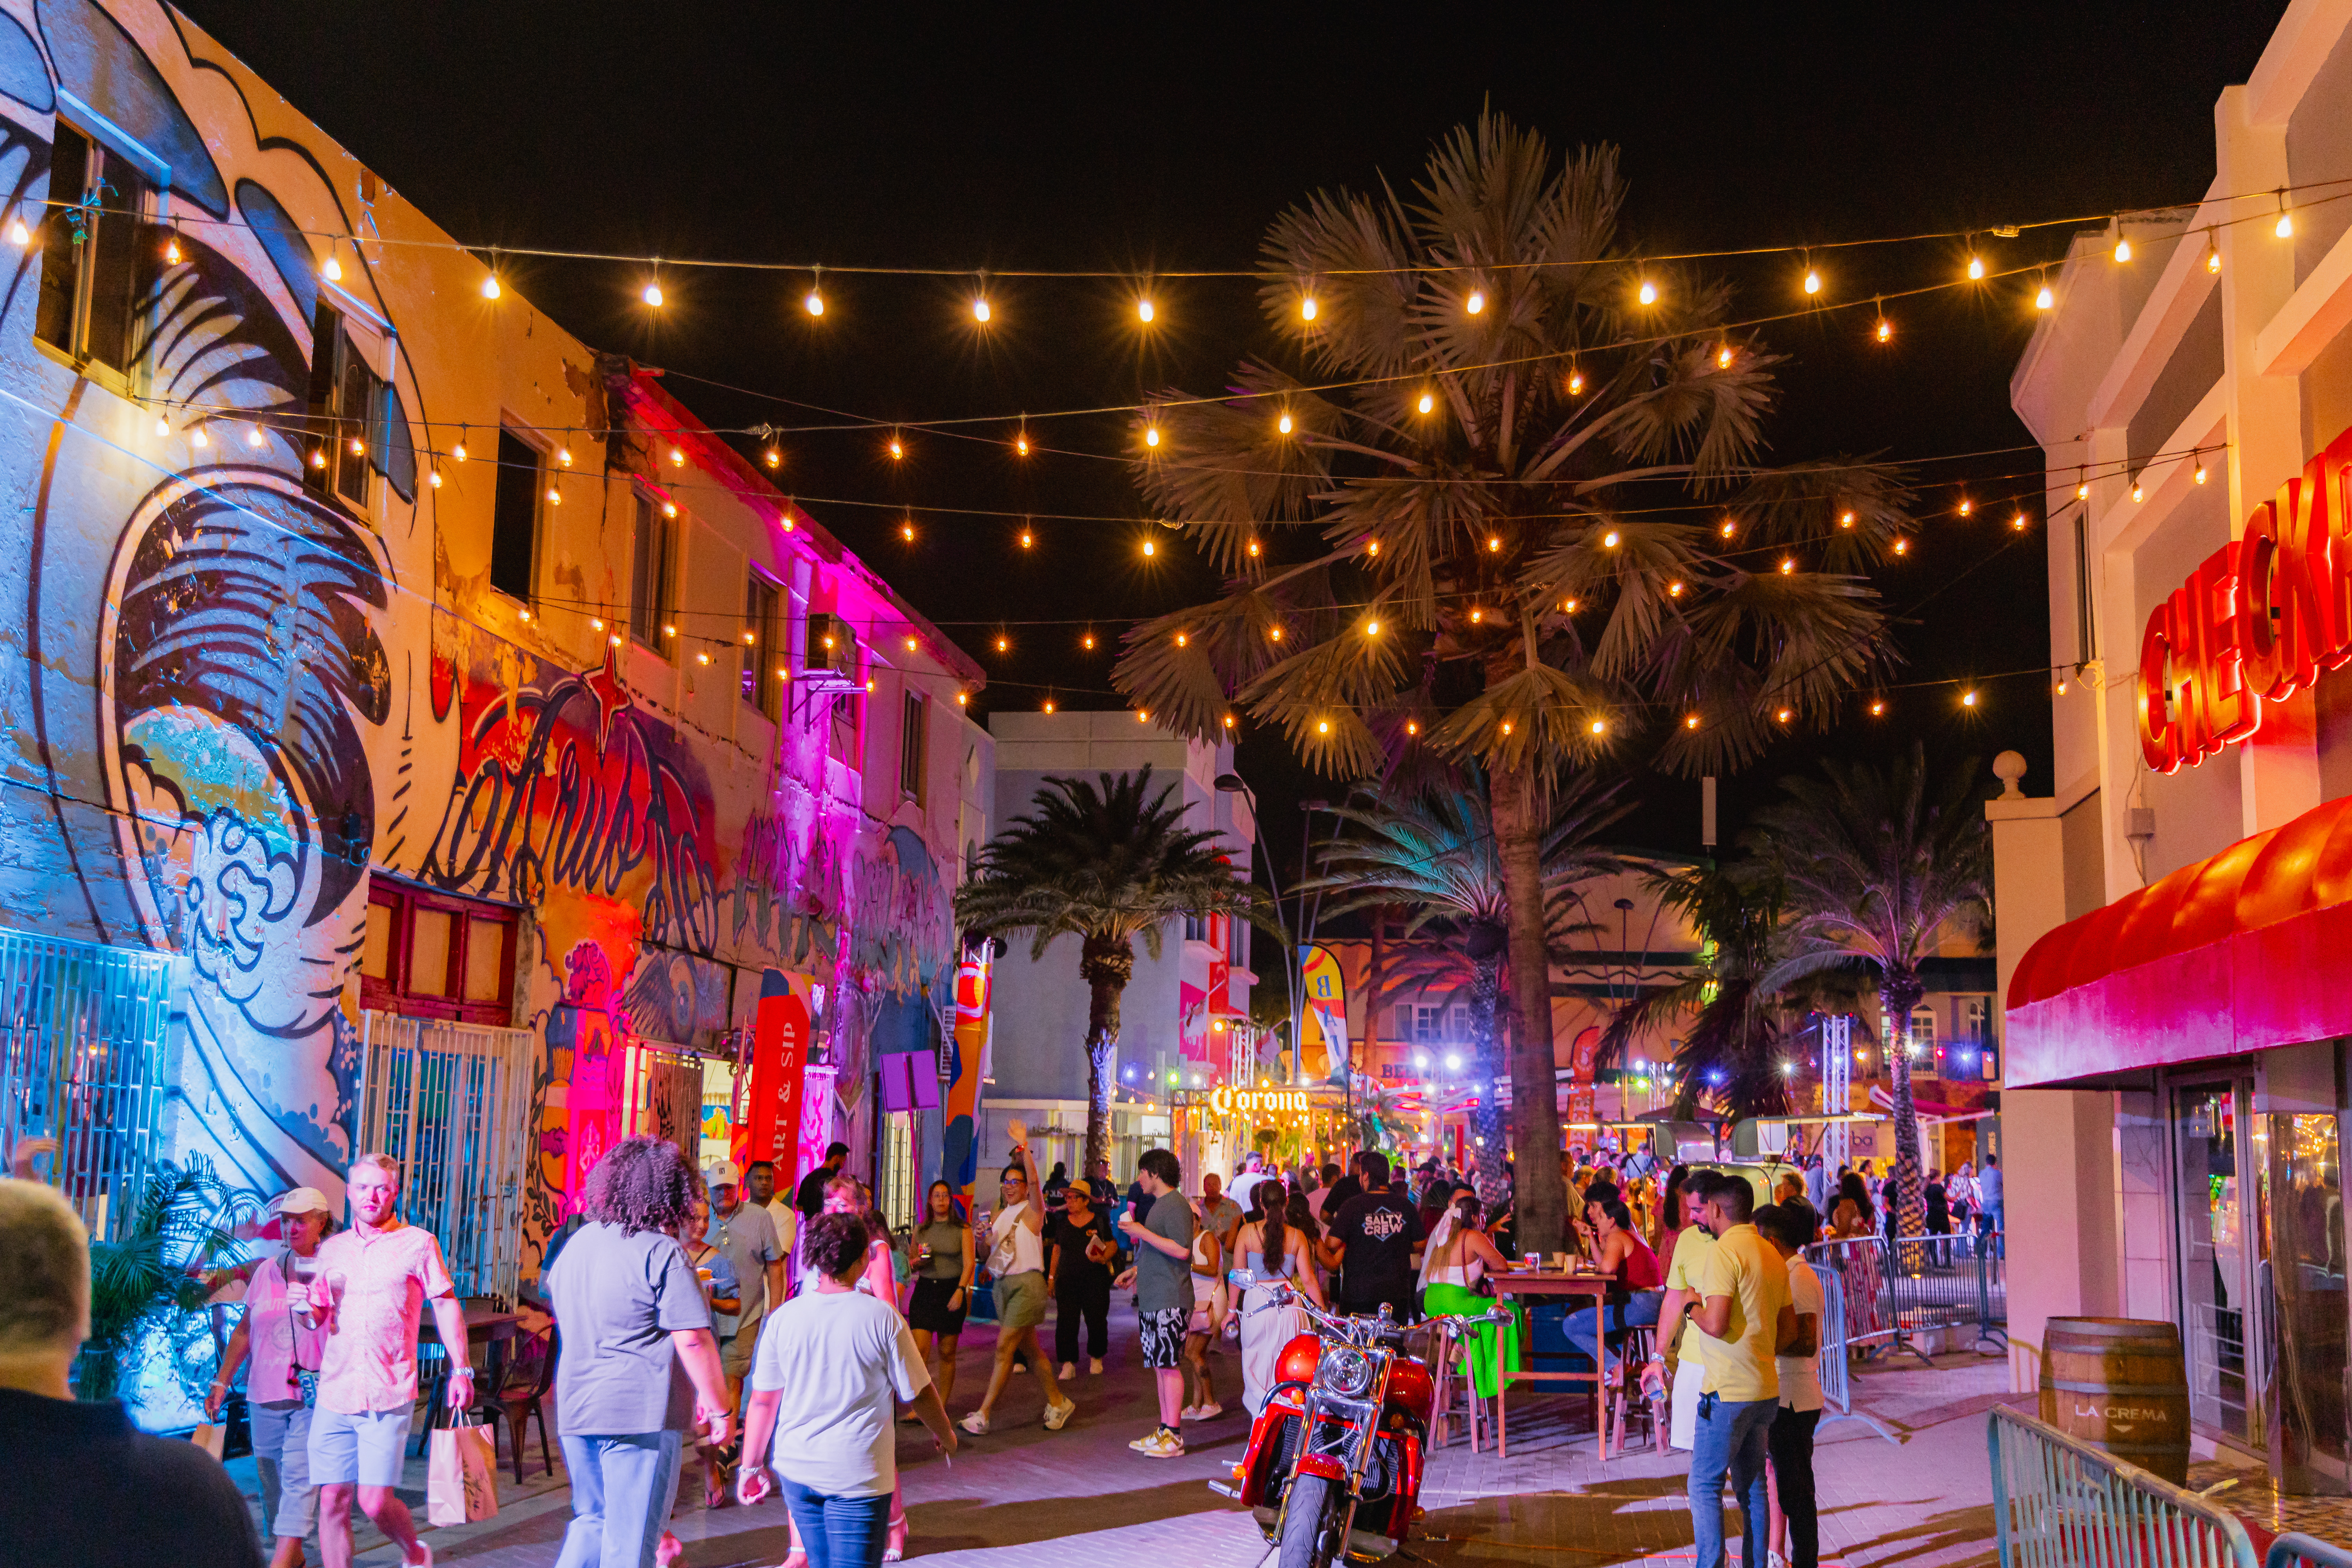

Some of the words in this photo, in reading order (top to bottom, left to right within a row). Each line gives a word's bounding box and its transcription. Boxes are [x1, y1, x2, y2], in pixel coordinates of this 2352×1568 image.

[781, 1022, 795, 1067] SIP
[778, 1080, 791, 1103] &
[1210, 1085, 1310, 1116] Corona
[771, 1114, 787, 1171] ART
[1364, 1223, 1403, 1235] CREW
[1365, 1214, 1403, 1226] SALTY
[2075, 1405, 2099, 1417] LA
[2104, 1406, 2167, 1422] CREMA
